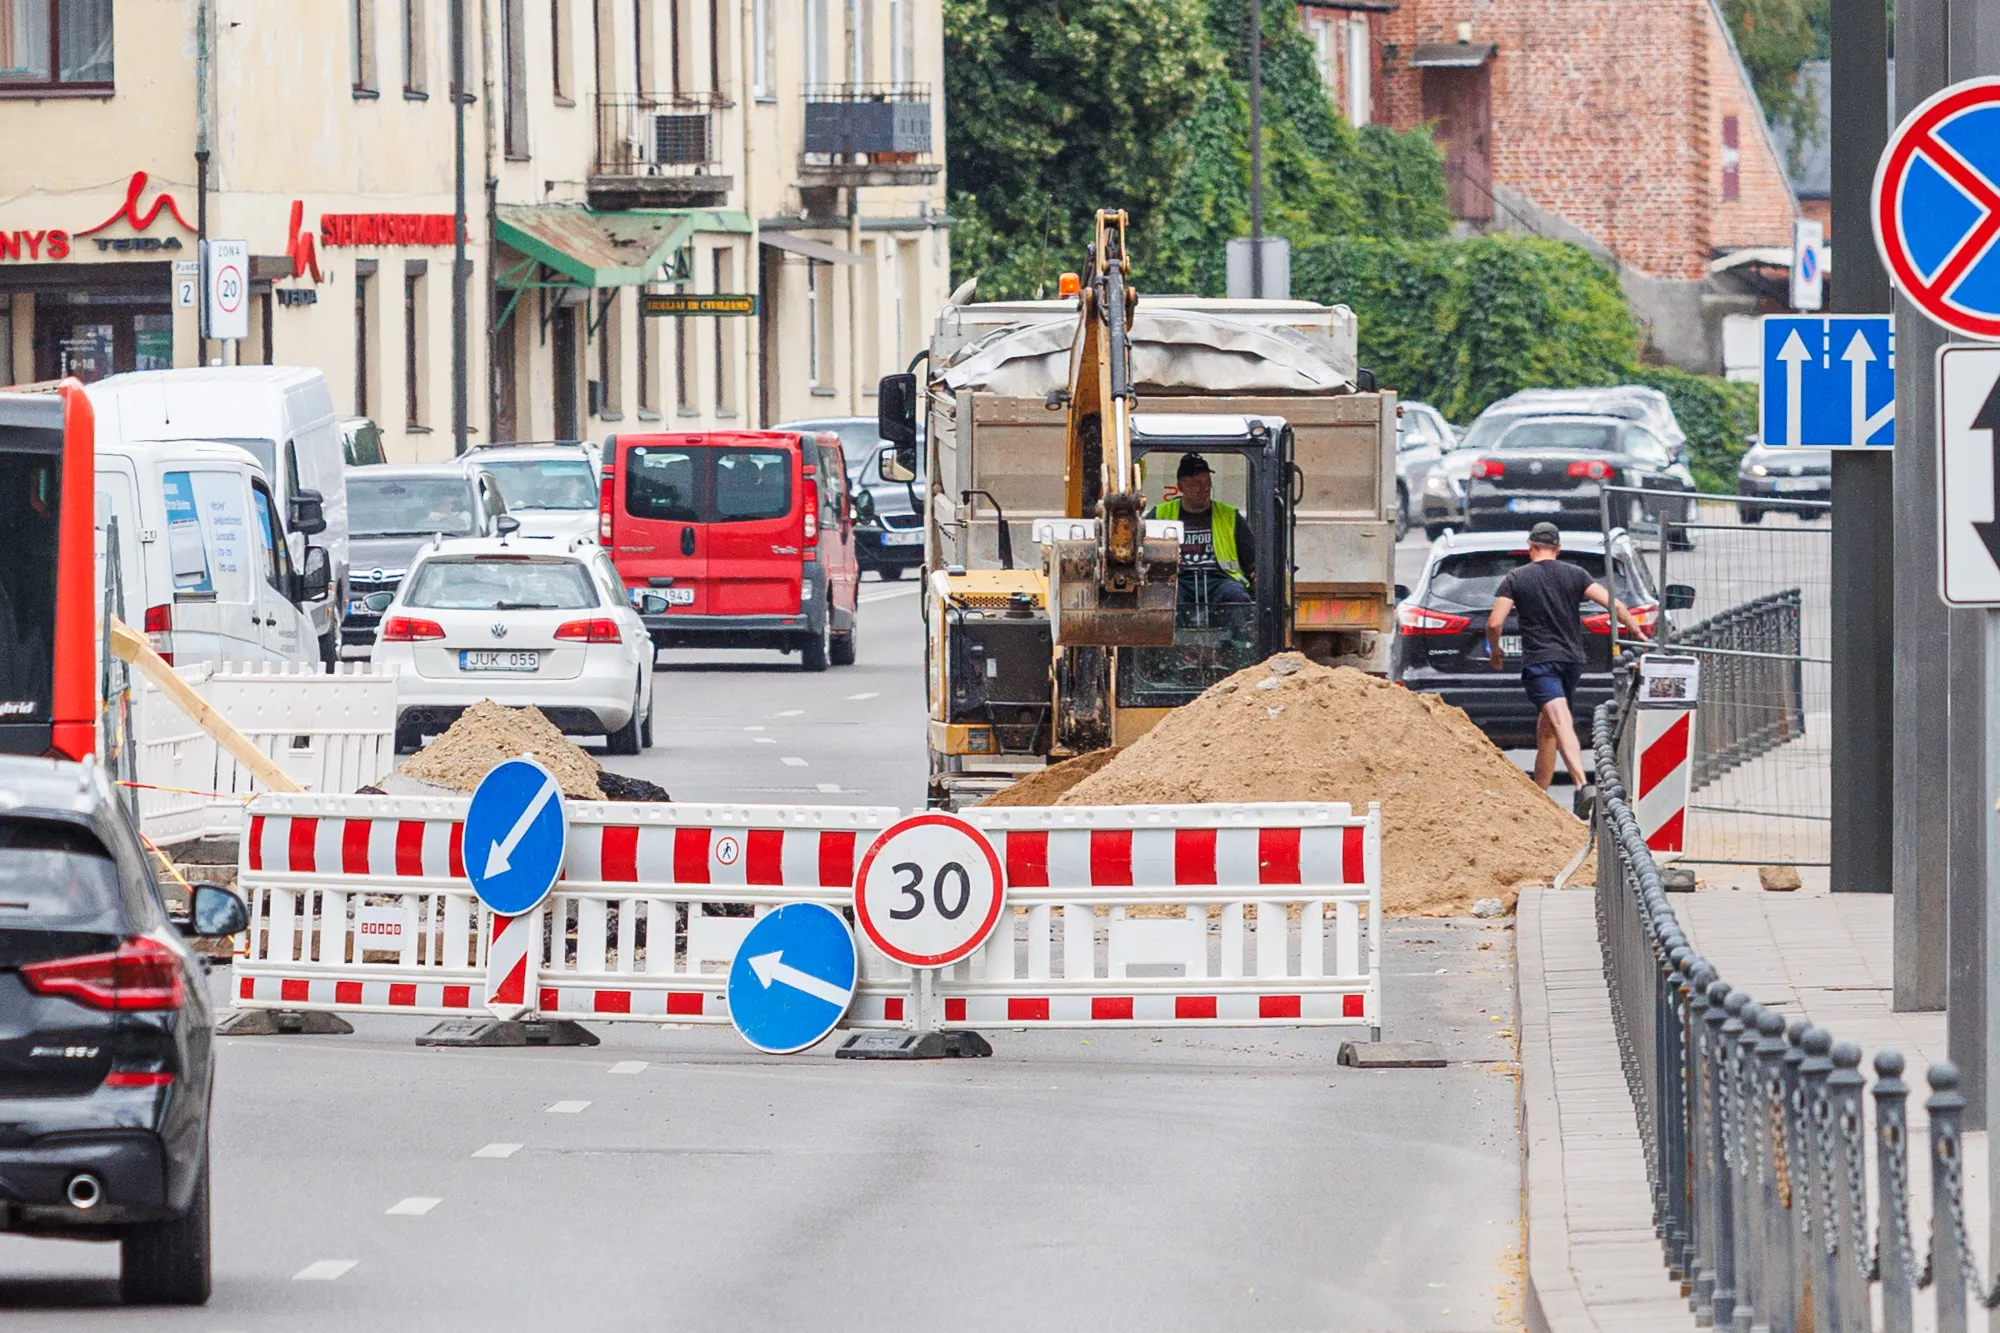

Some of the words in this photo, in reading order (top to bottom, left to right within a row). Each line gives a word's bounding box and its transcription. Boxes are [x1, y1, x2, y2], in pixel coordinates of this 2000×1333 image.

[0, 229, 70, 260] NYS
[92, 236, 183, 251] TEIDA
[218, 246, 240, 257] ZONA
[183, 284, 191, 303] 2
[223, 280, 237, 297] 20
[470, 653, 500, 666] JUK
[510, 653, 537, 666] 055
[889, 861, 971, 920] 30
